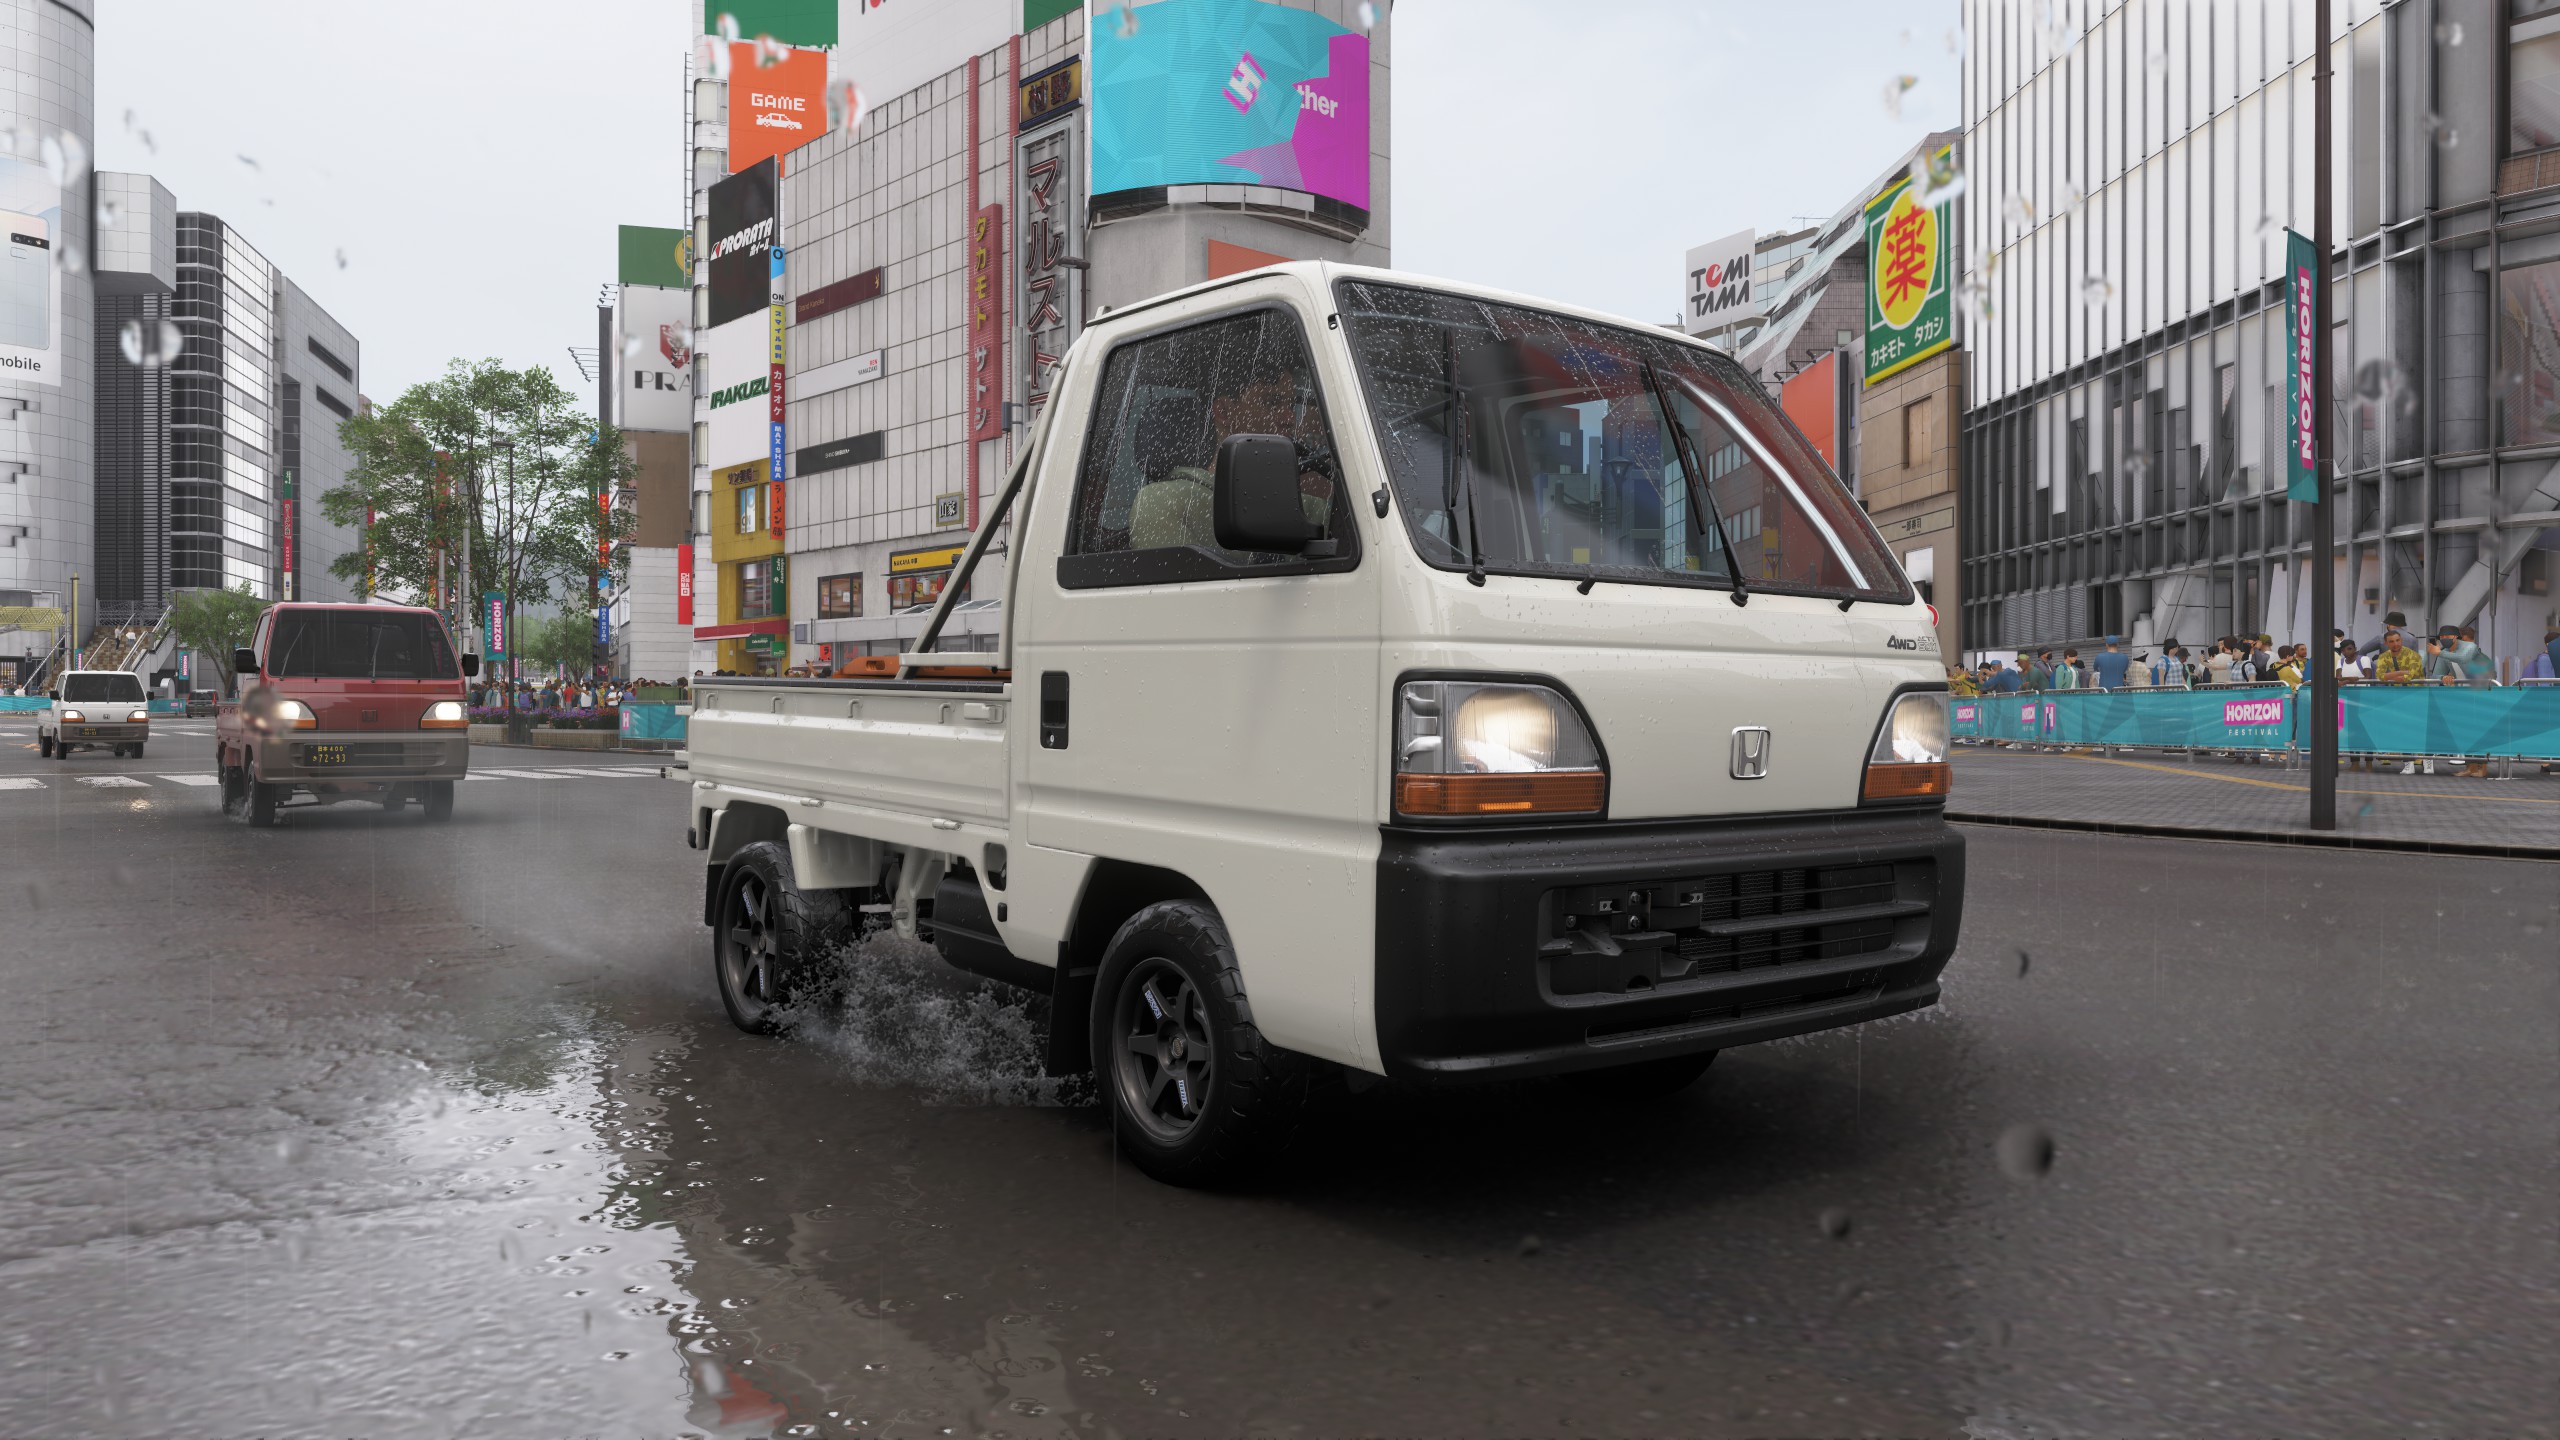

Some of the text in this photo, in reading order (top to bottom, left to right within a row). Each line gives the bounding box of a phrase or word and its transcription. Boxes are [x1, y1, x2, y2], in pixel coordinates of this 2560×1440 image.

[751, 92, 806, 112] GAME
[718, 216, 773, 258] PRORATA
[1885, 204, 1927, 312] 薬
[1690, 253, 1750, 293] TOMI
[1690, 279, 1750, 318] TAMA
[974, 216, 988, 432] タカモト サトシ
[1871, 316, 1944, 369] カキモト タカシ
[2290, 281, 2298, 448] FESTIVAL
[2300, 276, 2312, 461] HORIZON
[773, 370, 783, 416] カラオケ
[774, 425, 782, 479] MAX SHIMA
[493, 601, 502, 650] HORIZON
[1886, 634, 1917, 651] 4WD
[2226, 702, 2280, 722] HORIZON
[2228, 728, 2279, 736] FESTIVAL
